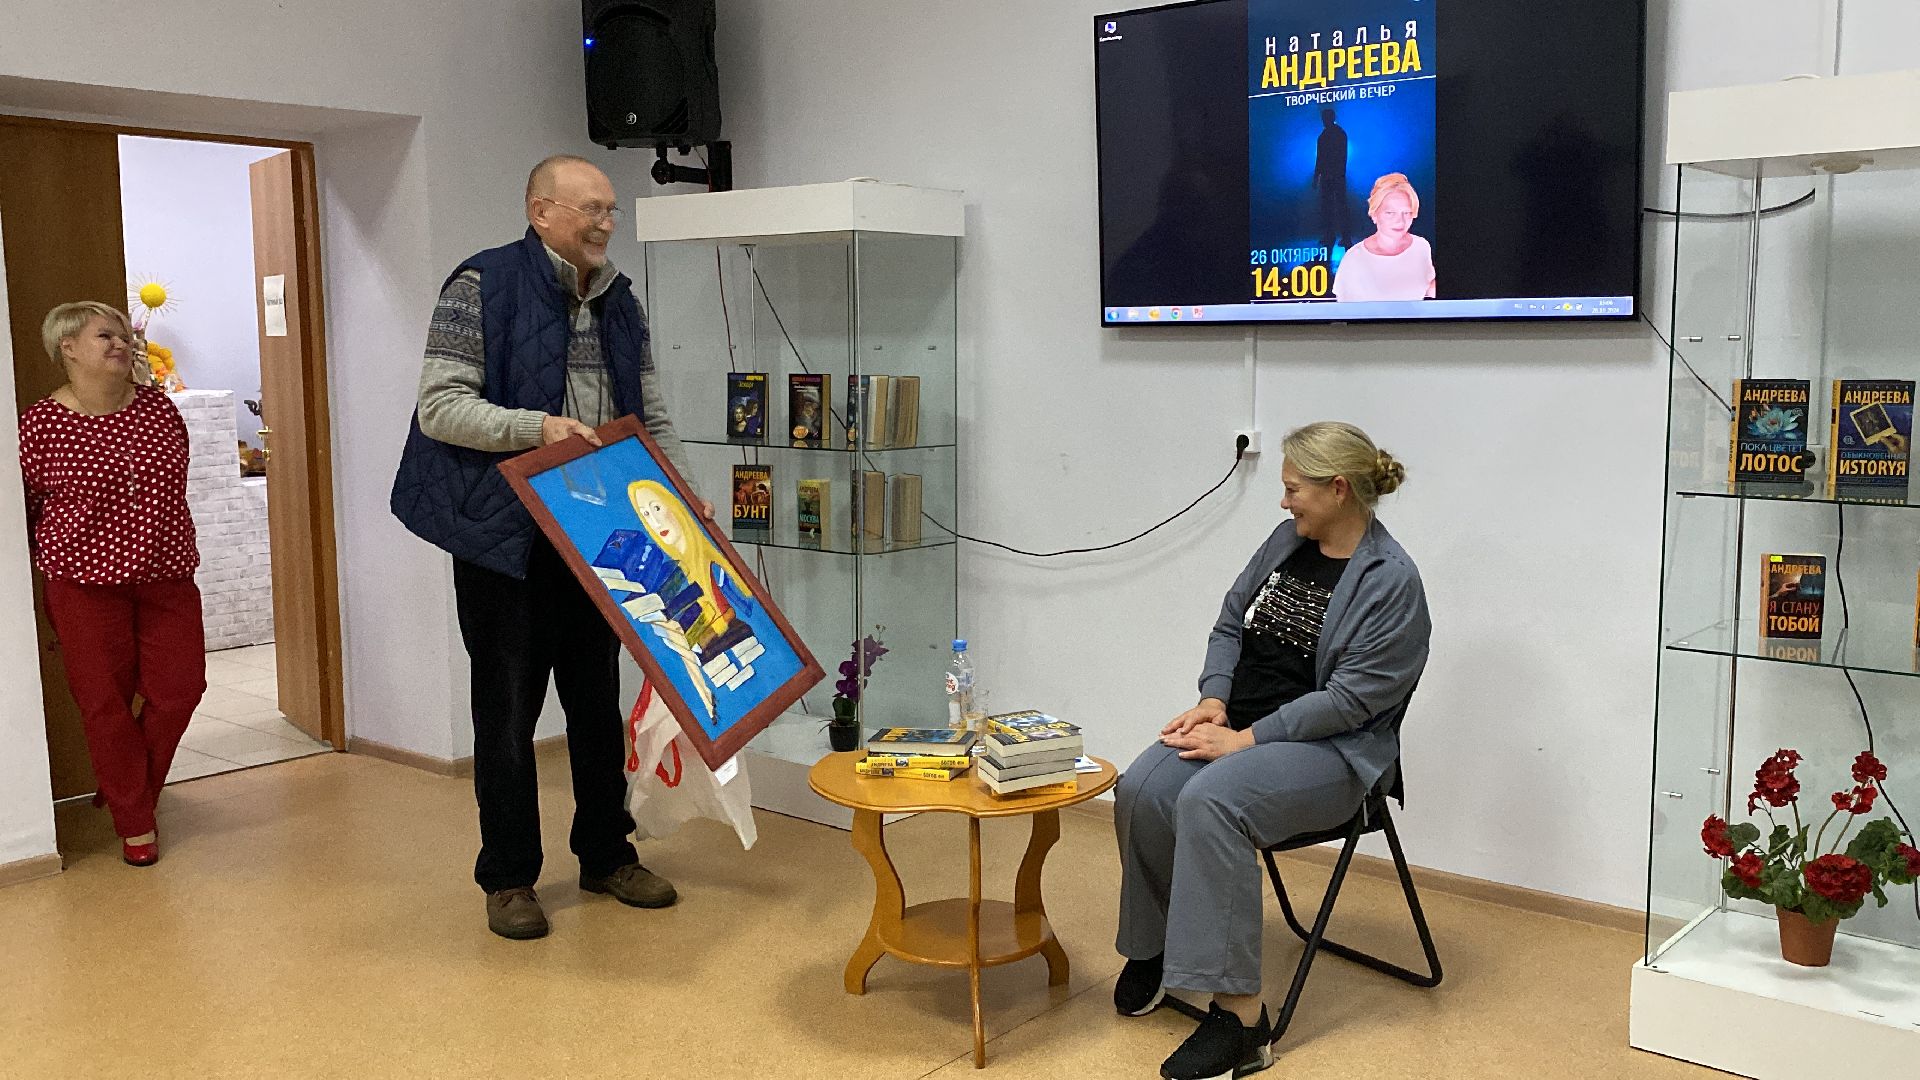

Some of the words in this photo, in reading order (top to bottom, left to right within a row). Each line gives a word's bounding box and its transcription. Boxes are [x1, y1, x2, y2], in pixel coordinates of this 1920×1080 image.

[1261, 39, 1422, 90] АНДРЕЕВА
[1285, 88, 1356, 107] ТВОРЧЕСКИЙ
[1360, 85, 1396, 98] ВЕЧЕР
[1250, 249, 1267, 265] 26
[1271, 247, 1328, 264] ОКТЯБРЯ
[1251, 265, 1328, 297] 14:00
[1744, 389, 1807, 404] АНДРЕЕВА
[1844, 390, 1910, 405] АНДРЕЕВА
[1740, 442, 1767, 452] ПОКА
[1769, 443, 1804, 454] ЦВЕТЕТ
[1740, 453, 1803, 473] ЛОТОС
[734, 470, 769, 480] АНДРЕЕВА
[734, 504, 768, 519] БУНТ
[1771, 564, 1822, 575] АНДРЕЕВА
[1769, 600, 1777, 613] Я
[1781, 601, 1820, 615] СТАНУ
[1769, 614, 1820, 633] ТОБОЙ
